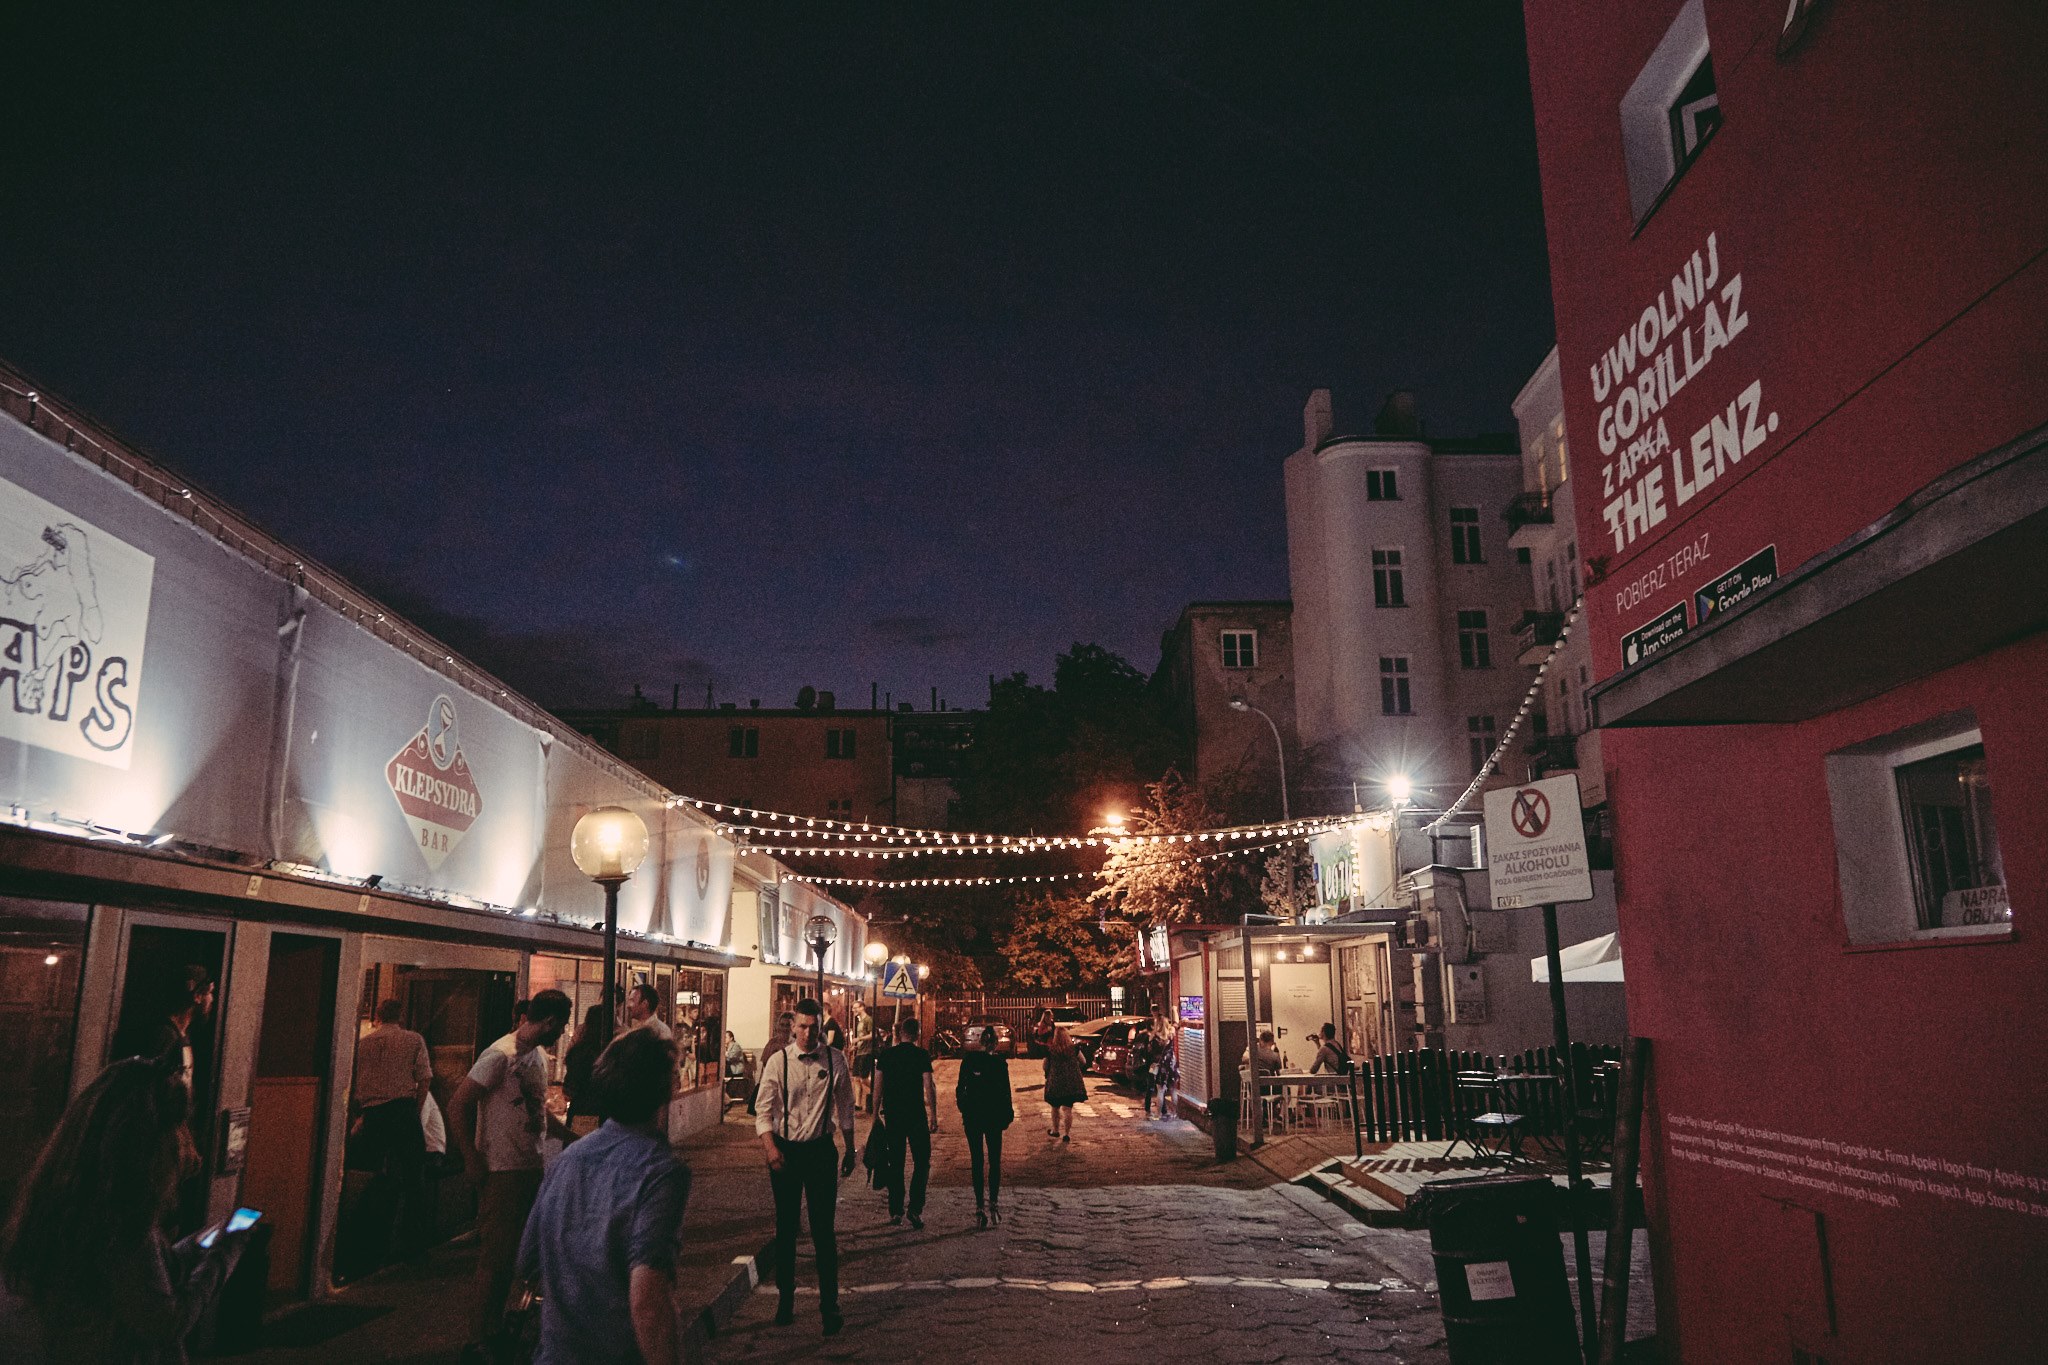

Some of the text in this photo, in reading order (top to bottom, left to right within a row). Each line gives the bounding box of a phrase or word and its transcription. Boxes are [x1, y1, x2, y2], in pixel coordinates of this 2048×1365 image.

[1591, 231, 1719, 402] UWOLNIJ
[1598, 272, 1748, 456] GORILLAZ
[1602, 463, 1615, 498] Z
[1603, 379, 1778, 553] THE LENZ.
[1616, 533, 1711, 614] POBIERZ TERAZ
[394, 763, 476, 818] KLEPSYDRA
[421, 828, 448, 852] BAR
[1493, 851, 1521, 863] ZAKAZ
[1505, 854, 1570, 875] ALKOHOLU
[1840, 1141, 1868, 1161] Google
[1885, 1149, 1909, 1167] Firma
[1911, 1153, 1937, 1171] Apple
[1943, 1158, 1965, 1178] logo
[1966, 1162, 1992, 1183] firmy
[1994, 1168, 2025, 1188] Apple
[1965, 1187, 1986, 1206] App
[1987, 1191, 2015, 1210] Store
[2016, 1199, 2028, 1213] to
